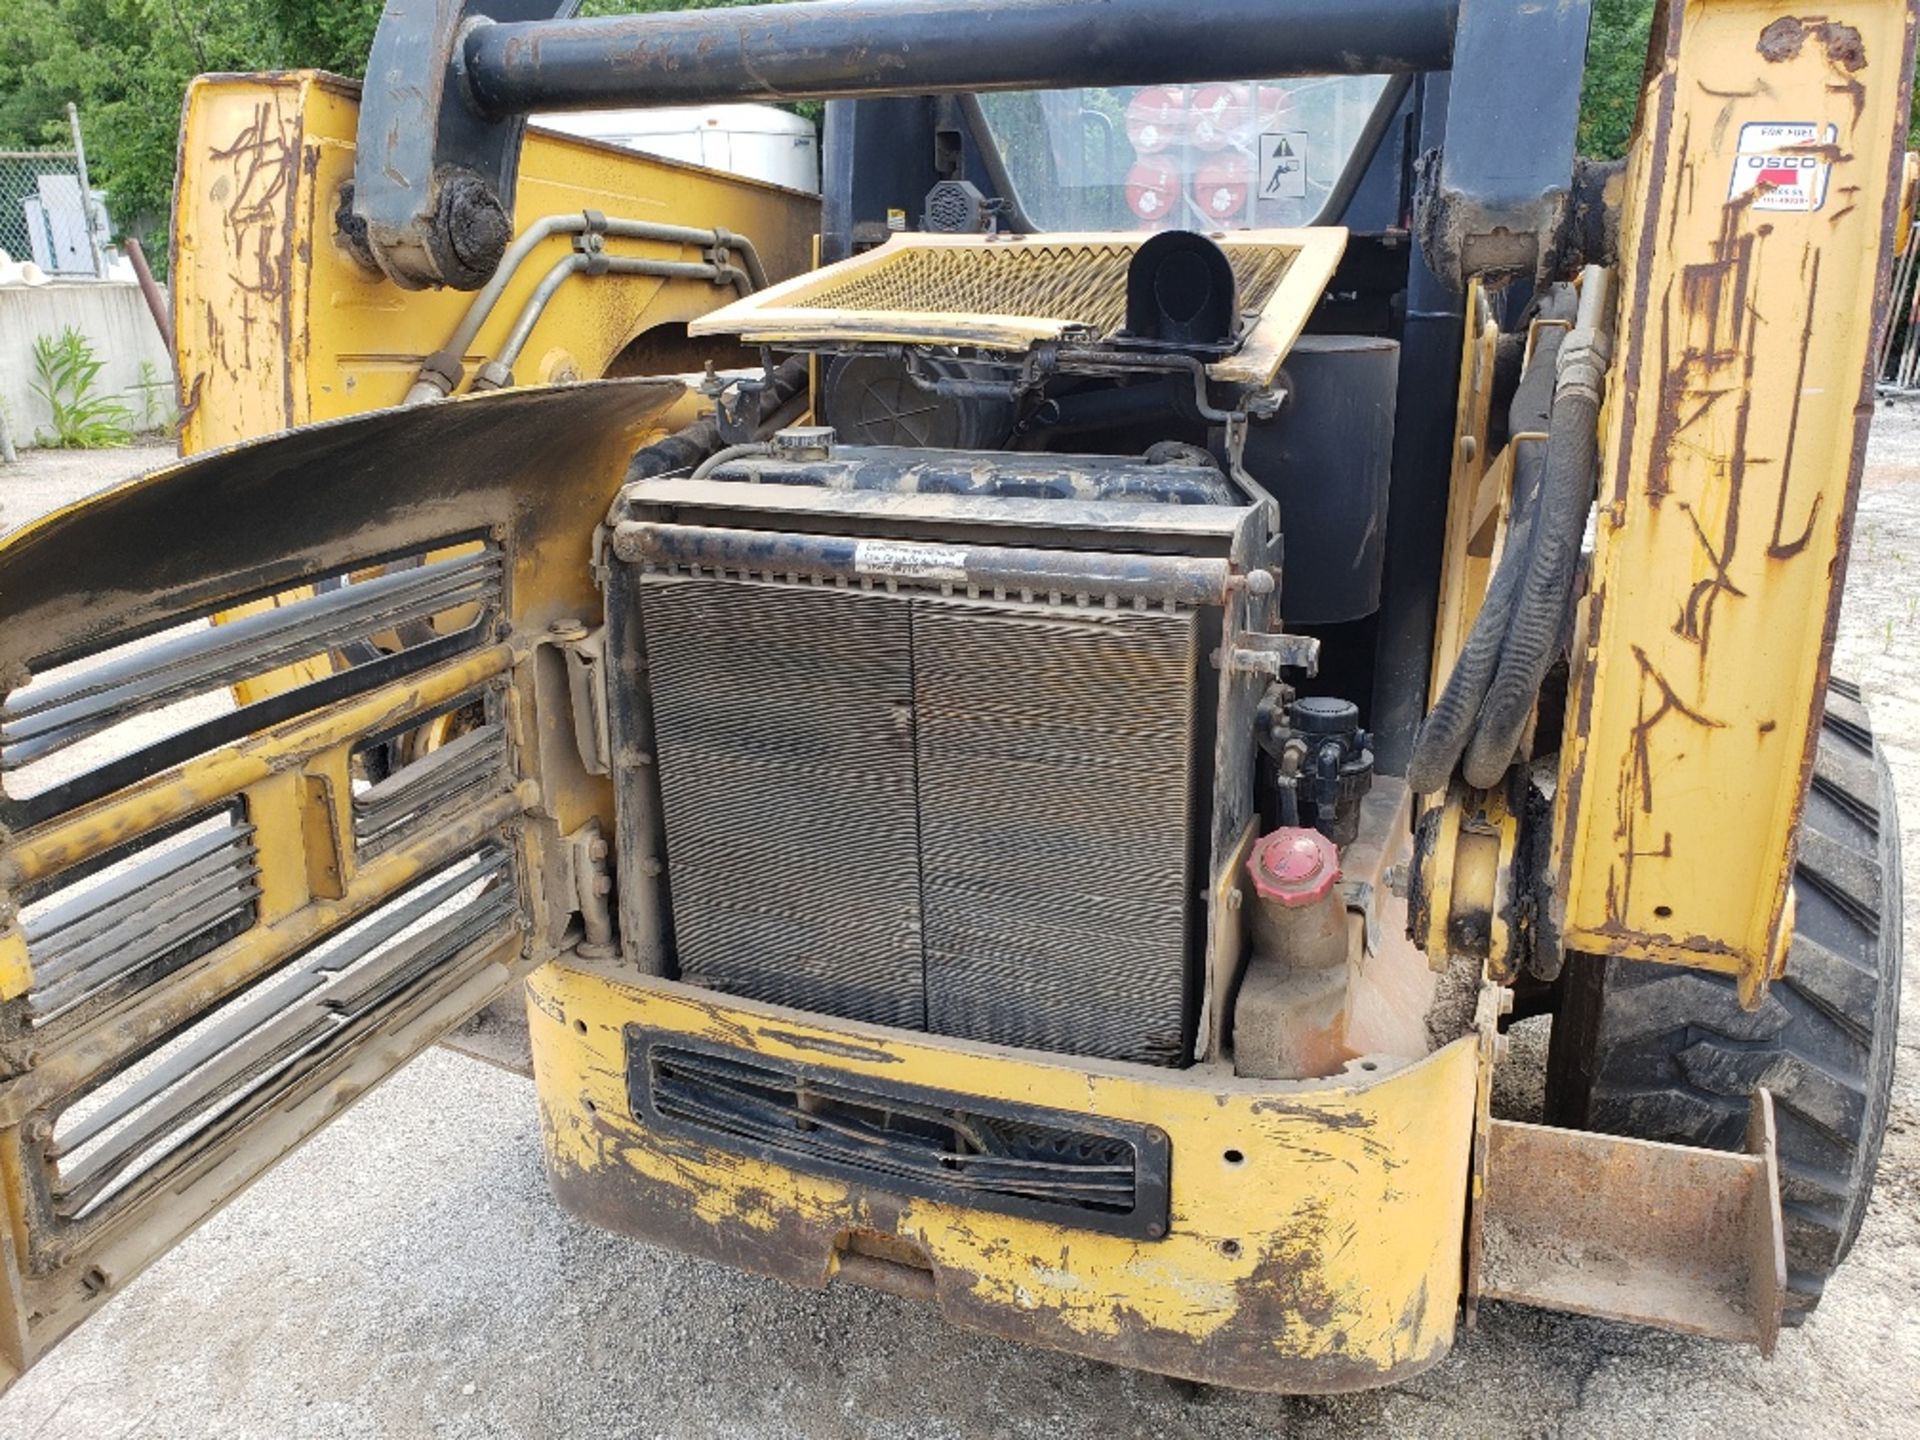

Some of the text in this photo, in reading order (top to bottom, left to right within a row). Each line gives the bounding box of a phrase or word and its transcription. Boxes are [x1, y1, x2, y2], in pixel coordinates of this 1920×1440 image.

[1761, 128, 1813, 136] FOR FUEL
[1748, 157, 1816, 168] OSCO
